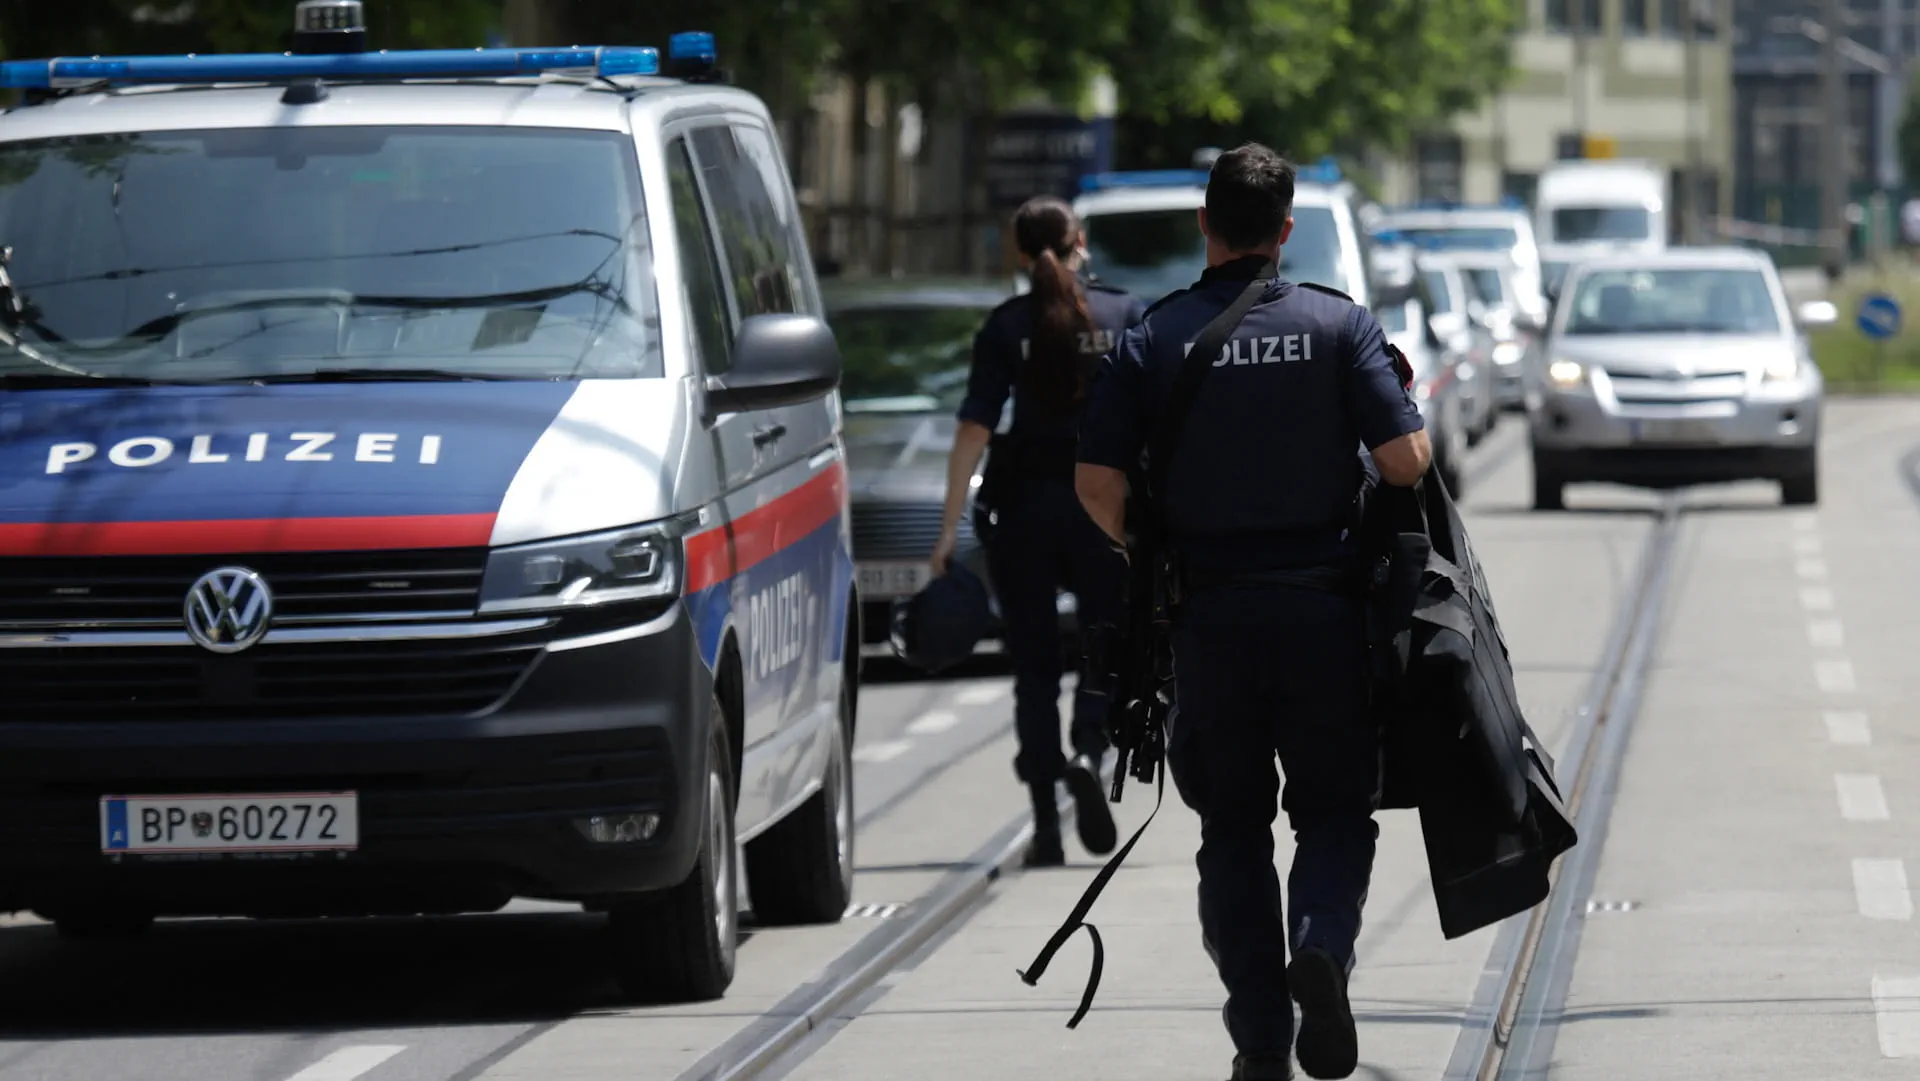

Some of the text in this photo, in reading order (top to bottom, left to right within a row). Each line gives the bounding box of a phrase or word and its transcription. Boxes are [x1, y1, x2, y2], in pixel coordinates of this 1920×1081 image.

[45, 432, 442, 475] POLIZEI
[185, 566, 272, 653] VW
[750, 570, 803, 683] POLIZEI
[140, 803, 338, 843] BP 60272
